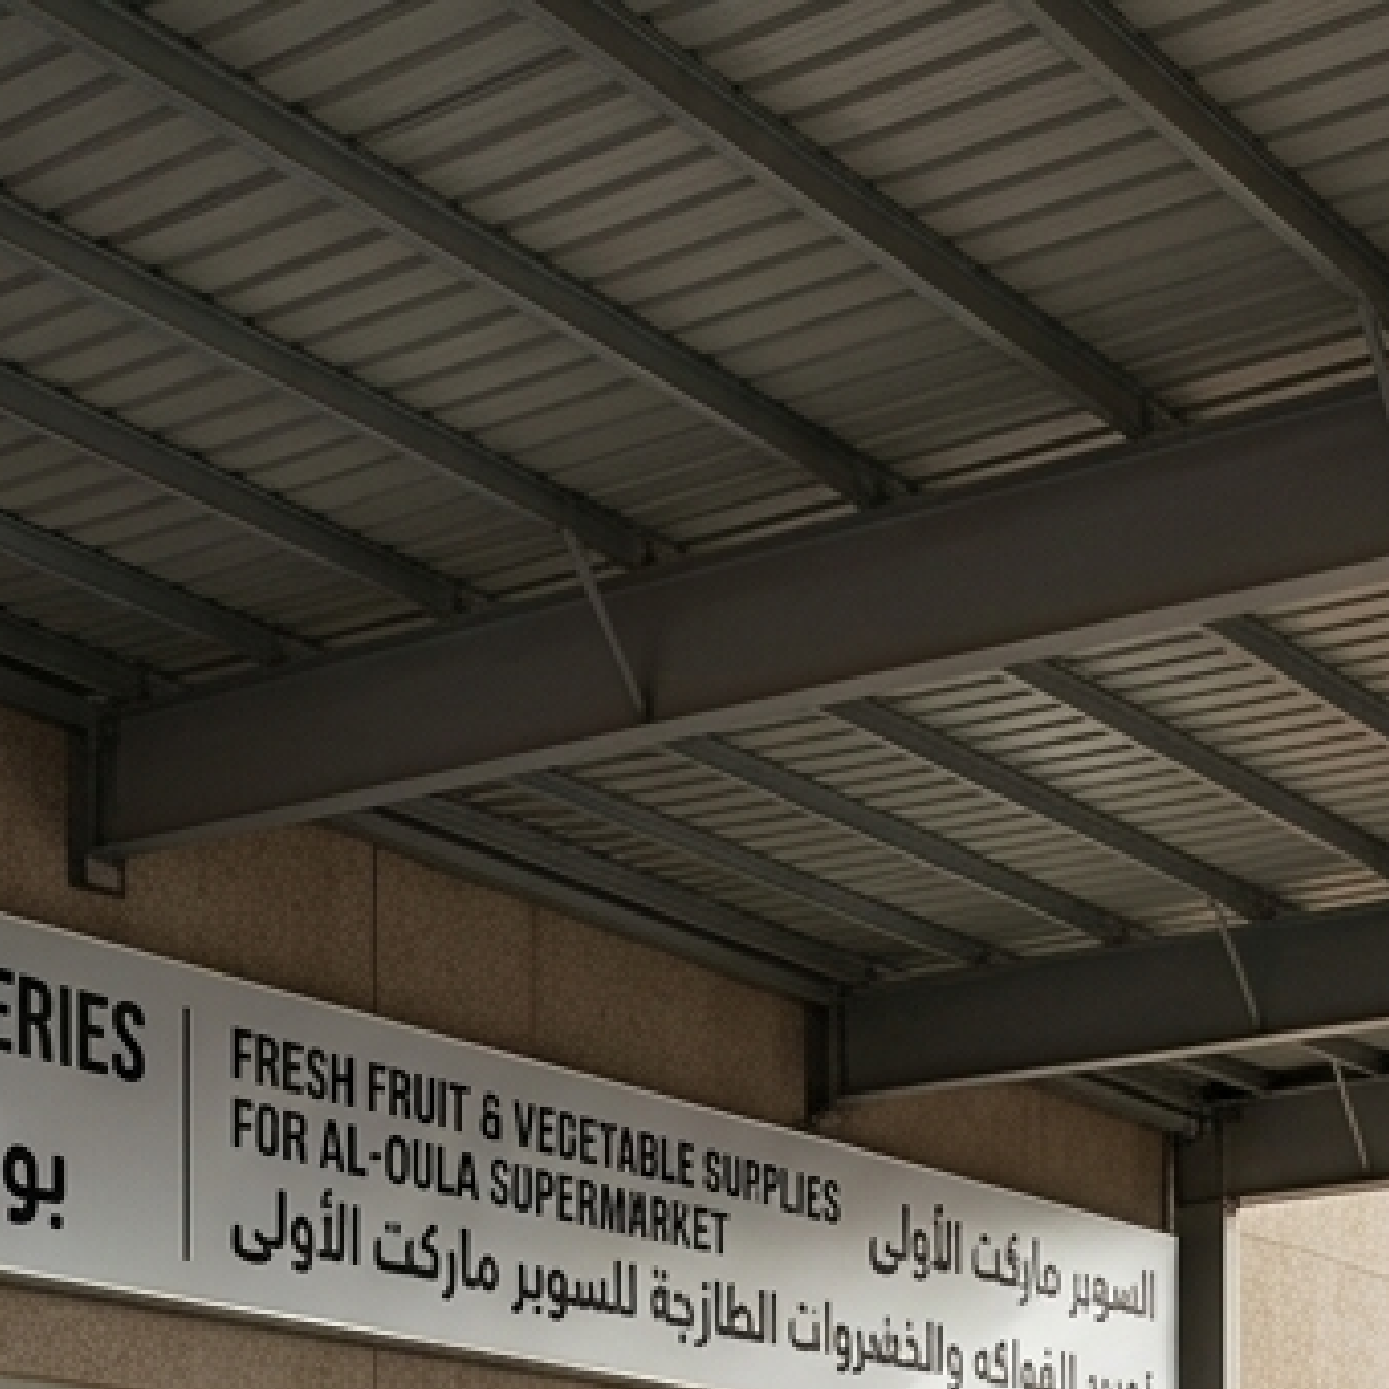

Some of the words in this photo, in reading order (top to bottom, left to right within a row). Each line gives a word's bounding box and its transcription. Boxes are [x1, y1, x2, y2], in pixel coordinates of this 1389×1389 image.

[233, 1025, 354, 1107] FRESH
[368, 1062, 471, 1131] FRUIT
[479, 1093, 504, 1140] &
[515, 1099, 694, 1189] VEGETABLE
[233, 1099, 309, 1165] FOR
[320, 1119, 479, 1201] AL-OULA
[491, 1157, 731, 1255] SUPERMARKET
[229, 1187, 357, 1275] الأولى
[372, 1219, 500, 1299] ماركت
[868, 1203, 963, 1282] الأولى
[510, 1259, 638, 1323] للسوبر
[649, 1263, 777, 1347] الطازجة
